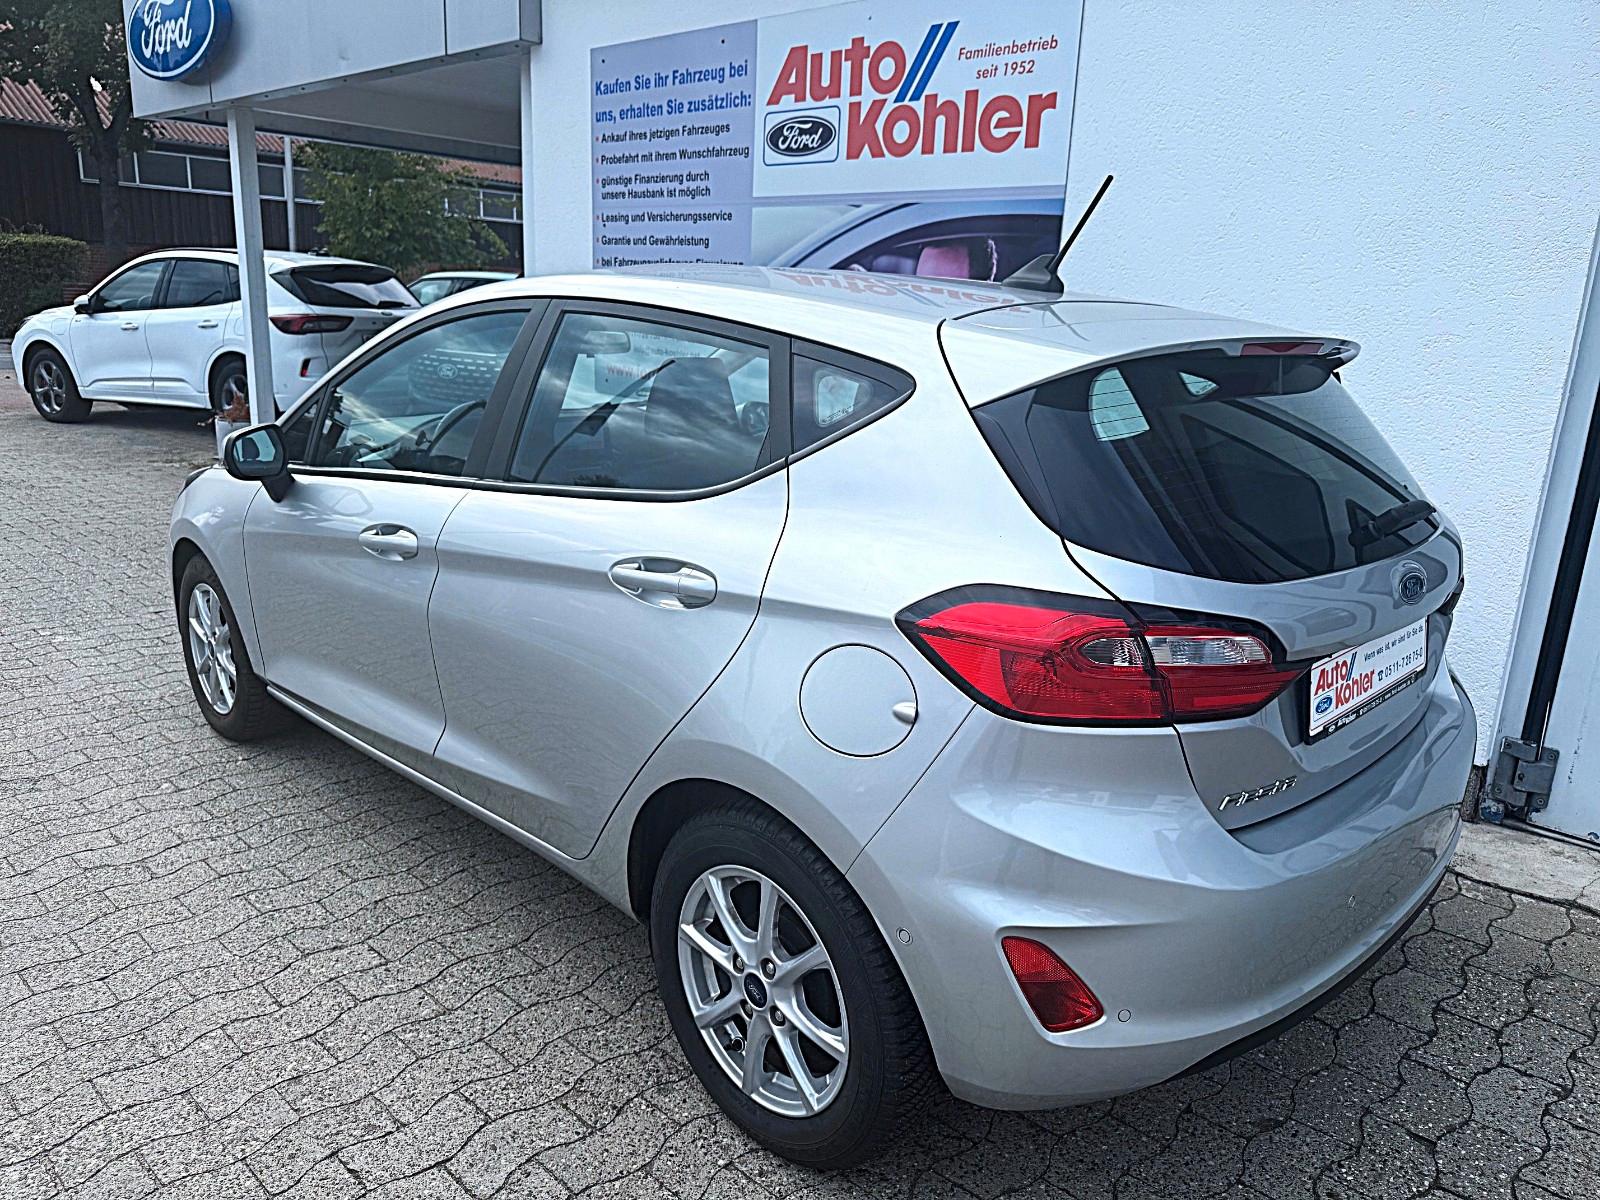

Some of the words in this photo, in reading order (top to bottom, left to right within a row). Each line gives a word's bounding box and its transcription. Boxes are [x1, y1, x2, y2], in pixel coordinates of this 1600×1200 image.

[141, 0, 192, 59] Ford
[958, 34, 1058, 61] Familienbetrieb
[595, 78, 631, 96] Kaufen
[634, 75, 651, 91] Sie
[654, 72, 669, 89] ihr
[672, 66, 725, 85] Fahrzeug
[729, 59, 748, 77] bei
[766, 36, 907, 107] Auto
[975, 64, 998, 80] seit
[1002, 59, 1035, 77] 1952
[595, 109, 617, 124] uns,
[619, 102, 663, 120] erhalten
[666, 99, 684, 115] Sie
[687, 90, 752, 113] zusätzlich:
[601, 130, 627, 144] Ankauf
[628, 129, 648, 141] ihres
[649, 126, 680, 142] jetzigen
[681, 122, 731, 137] Fahrzeuges
[778, 121, 822, 150] Ford
[600, 153, 640, 165] Probefahrt
[641, 152, 653, 163] mit
[654, 151, 677, 162] ihrem
[678, 146, 750, 160] Wunschfahrzeug
[601, 175, 633, 189] günstige
[634, 172, 684, 186] Finanzierung
[685, 170, 710, 183] durch
[601, 190, 626, 200] unsere
[627, 188, 665, 199] Hausbank
[666, 187, 677, 198] ist
[678, 186, 711, 199] möglich
[601, 212, 630, 224] Leasing
[631, 211, 645, 222] und
[646, 210, 733, 224] Versicherungsservice
[601, 235, 631, 246] Garantie
[633, 235, 647, 246] und
[648, 235, 710, 249] Gewährleistung
[1314, 660, 1349, 696] Auto
